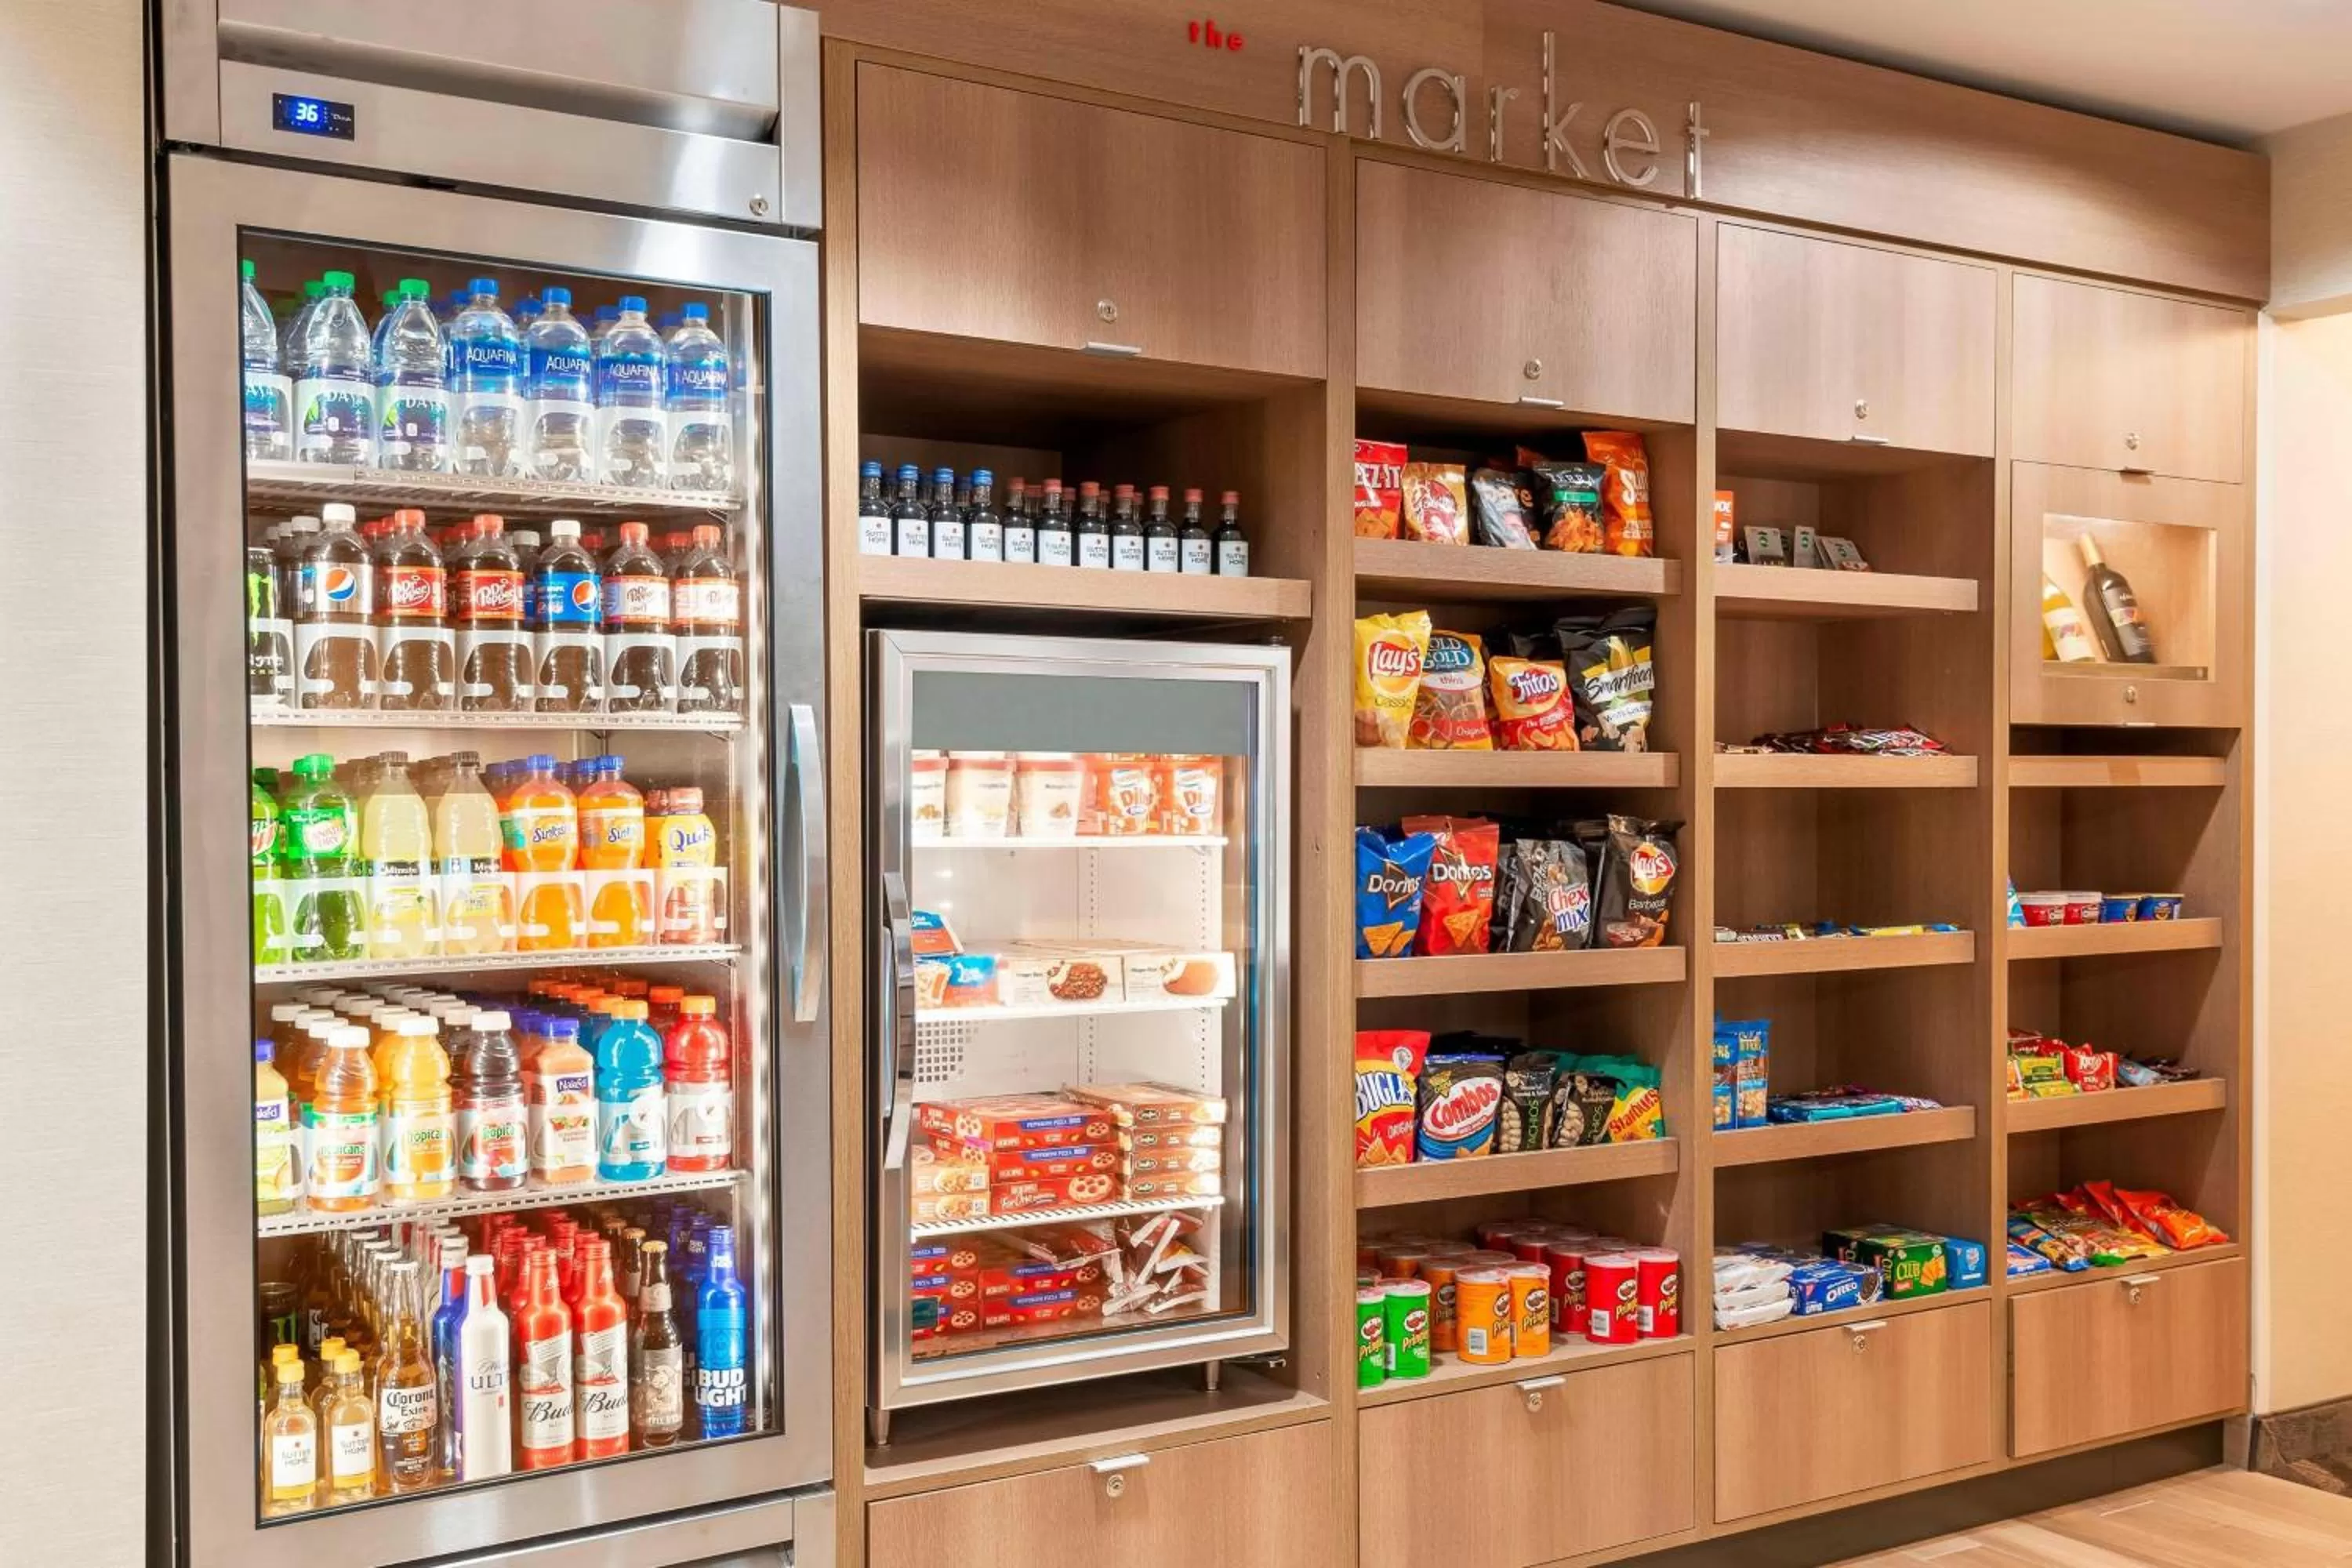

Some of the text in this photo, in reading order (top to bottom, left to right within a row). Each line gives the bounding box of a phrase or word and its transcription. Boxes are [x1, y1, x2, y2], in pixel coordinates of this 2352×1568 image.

[1189, 20, 1244, 52] the
[296, 102, 318, 122] 36
[1298, 31, 1710, 200] market
[466, 347, 517, 365] AQUAFINA
[546, 355, 590, 374] AQUAFIN
[1429, 637, 1461, 650] OLD
[1373, 643, 1420, 677] Lay's
[1507, 672, 1560, 704] Fritos
[1432, 863, 1492, 881] Doritos
[1548, 885, 1588, 913] Chex
[559, 1077, 588, 1091] Naked
[256, 1105, 278, 1119] aked
[1431, 1083, 1499, 1129] Combos
[1609, 1088, 1660, 1134] Starburs
[483, 1123, 515, 1139] Tropica
[1529, 1099, 1540, 1145] ACHIOS
[1827, 1282, 1857, 1302] OREO
[470, 1373, 503, 1389] ULT
[699, 1367, 745, 1387] BUD
[387, 1388, 434, 1409] Corona
[695, 1383, 747, 1407] LIGHT
